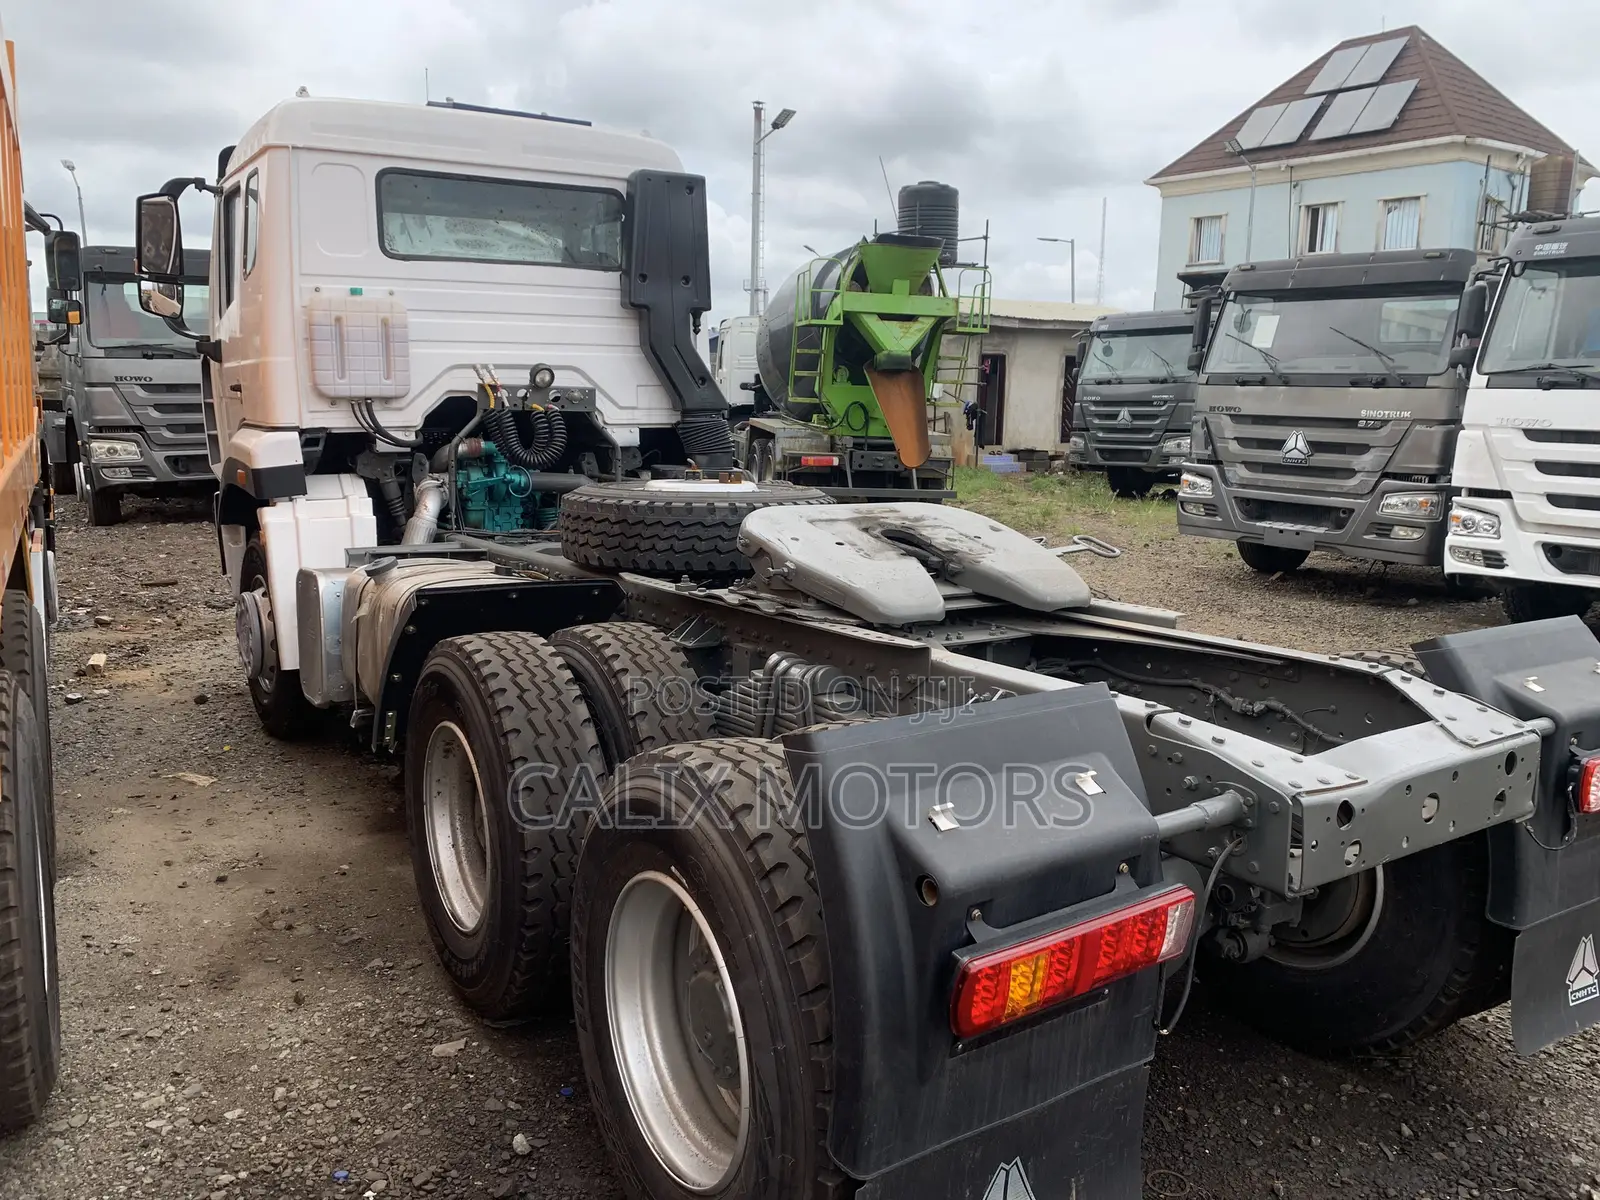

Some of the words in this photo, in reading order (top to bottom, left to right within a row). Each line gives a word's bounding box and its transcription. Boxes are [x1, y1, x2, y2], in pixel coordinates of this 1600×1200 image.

[113, 375, 153, 383] HOWO
[1208, 405, 1242, 413] HOWO
[1360, 409, 1412, 418] SINOTRUK
[1571, 985, 1597, 1000] CNHTC
